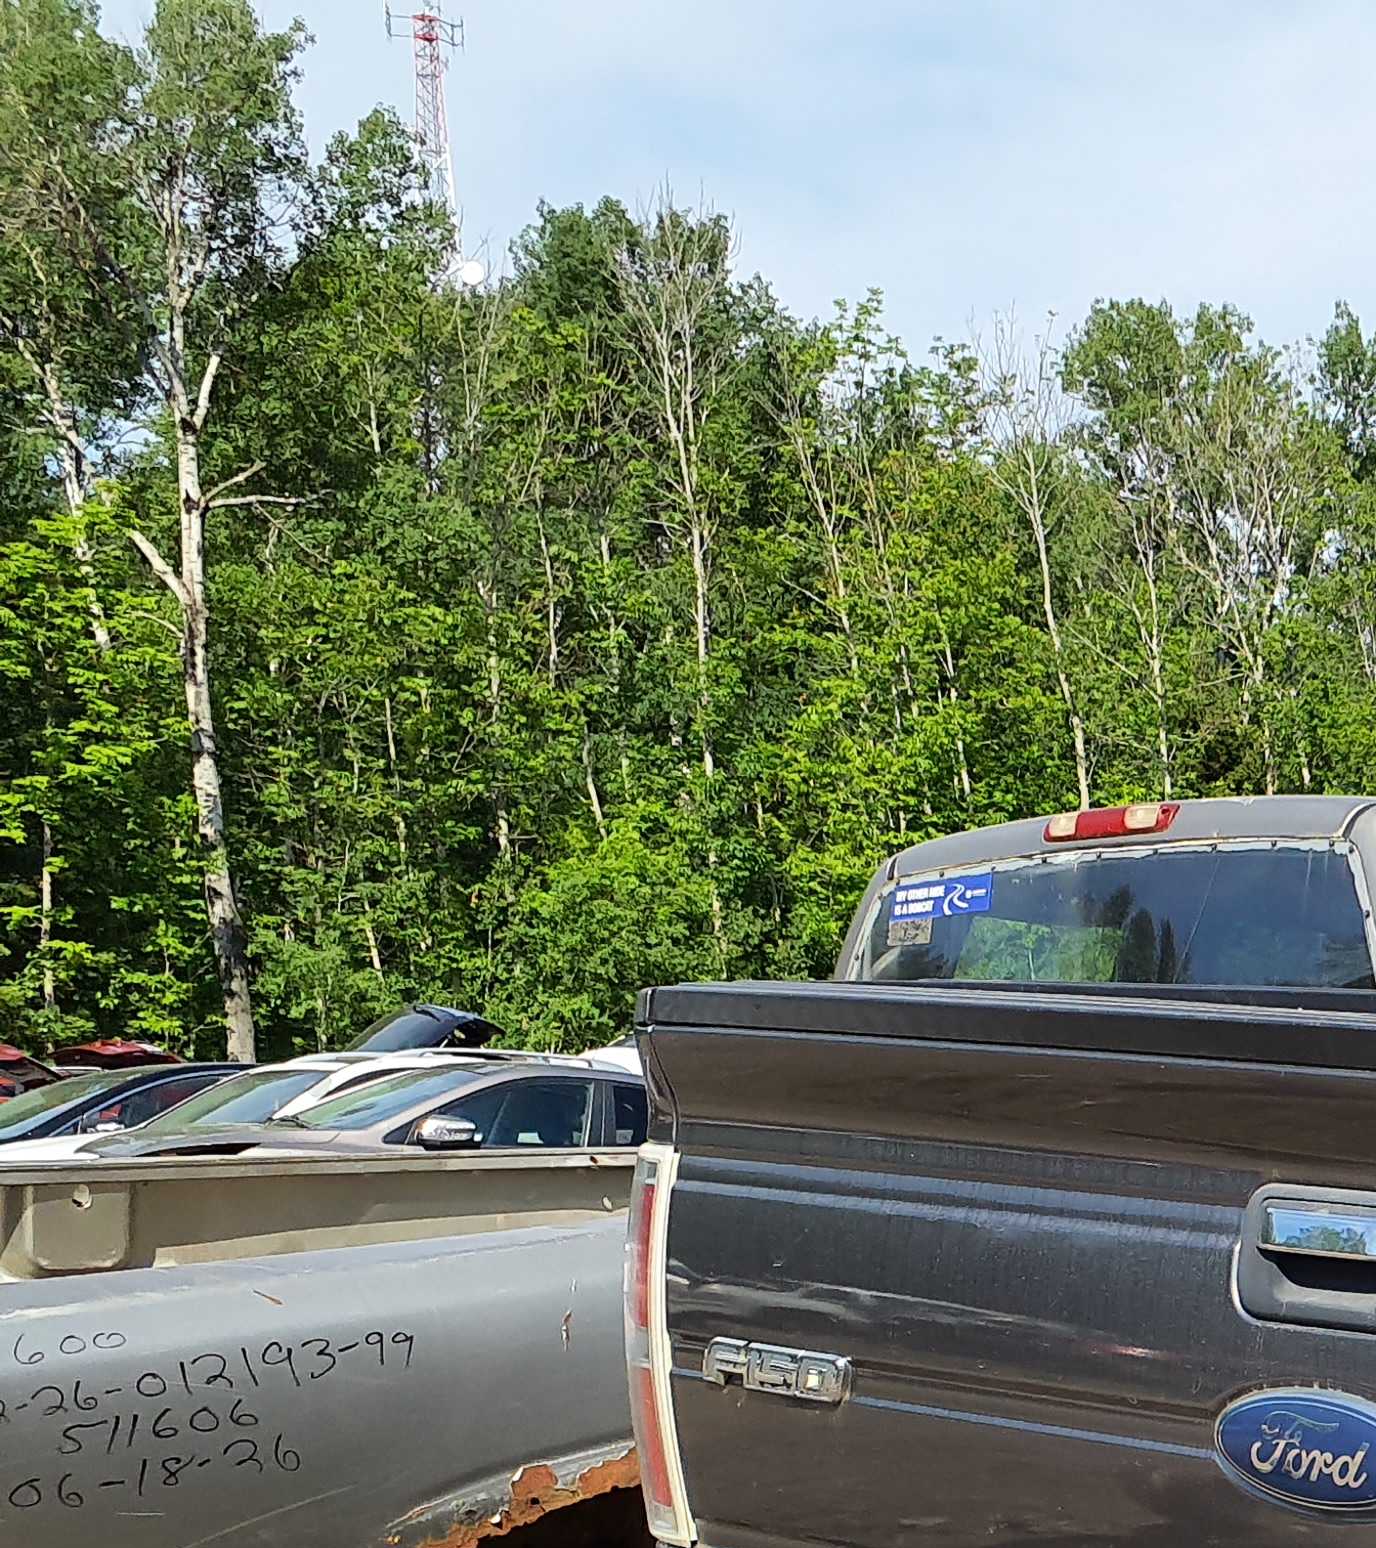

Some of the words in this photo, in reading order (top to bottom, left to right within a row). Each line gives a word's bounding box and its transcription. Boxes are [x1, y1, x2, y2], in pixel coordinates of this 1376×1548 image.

[13, 1332, 127, 1365] 600
[57, 1399, 258, 1455] 511606
[1251, 1410, 1371, 1489] Ford
[9, 1433, 301, 1508] 06-18-26
